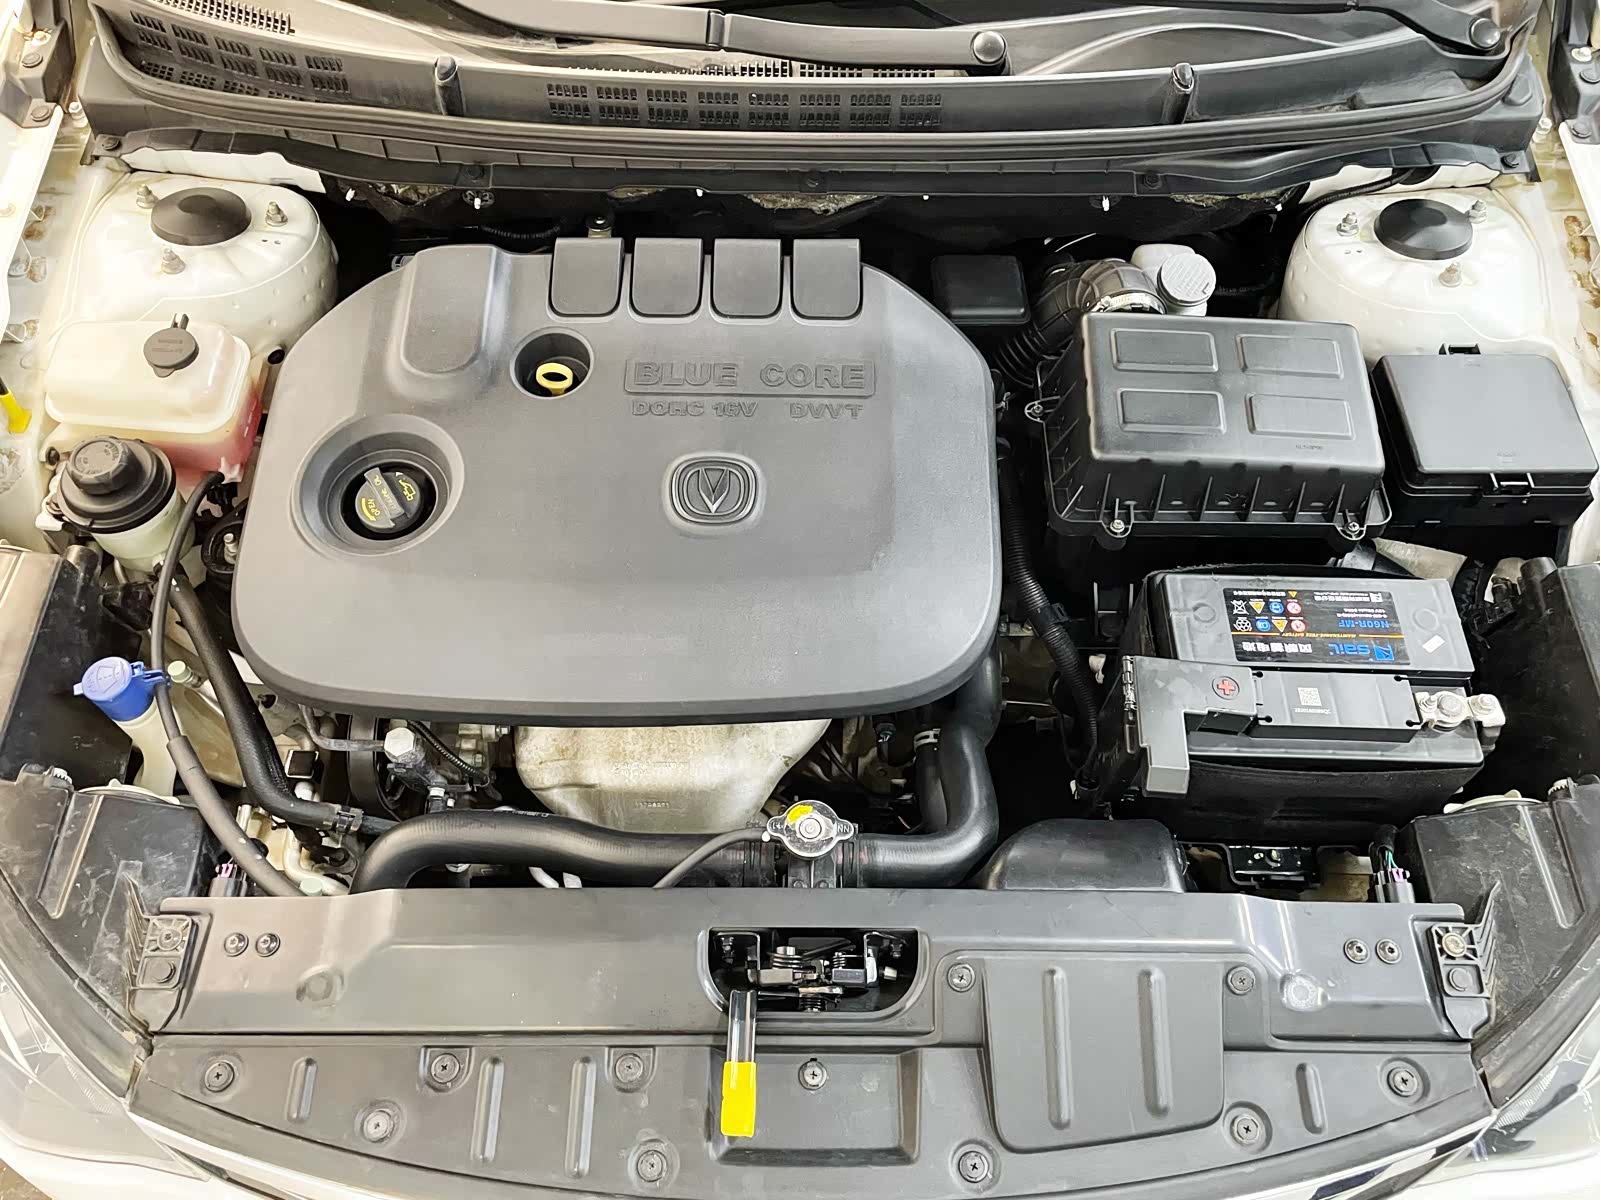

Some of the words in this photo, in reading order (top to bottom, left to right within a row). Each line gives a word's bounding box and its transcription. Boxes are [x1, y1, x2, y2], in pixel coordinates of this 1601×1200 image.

[634, 361, 738, 387] BLUE
[760, 363, 866, 389] CORE
[632, 400, 704, 417] DOHC
[712, 401, 758, 418] 16V
[789, 403, 863, 419] DVVT
